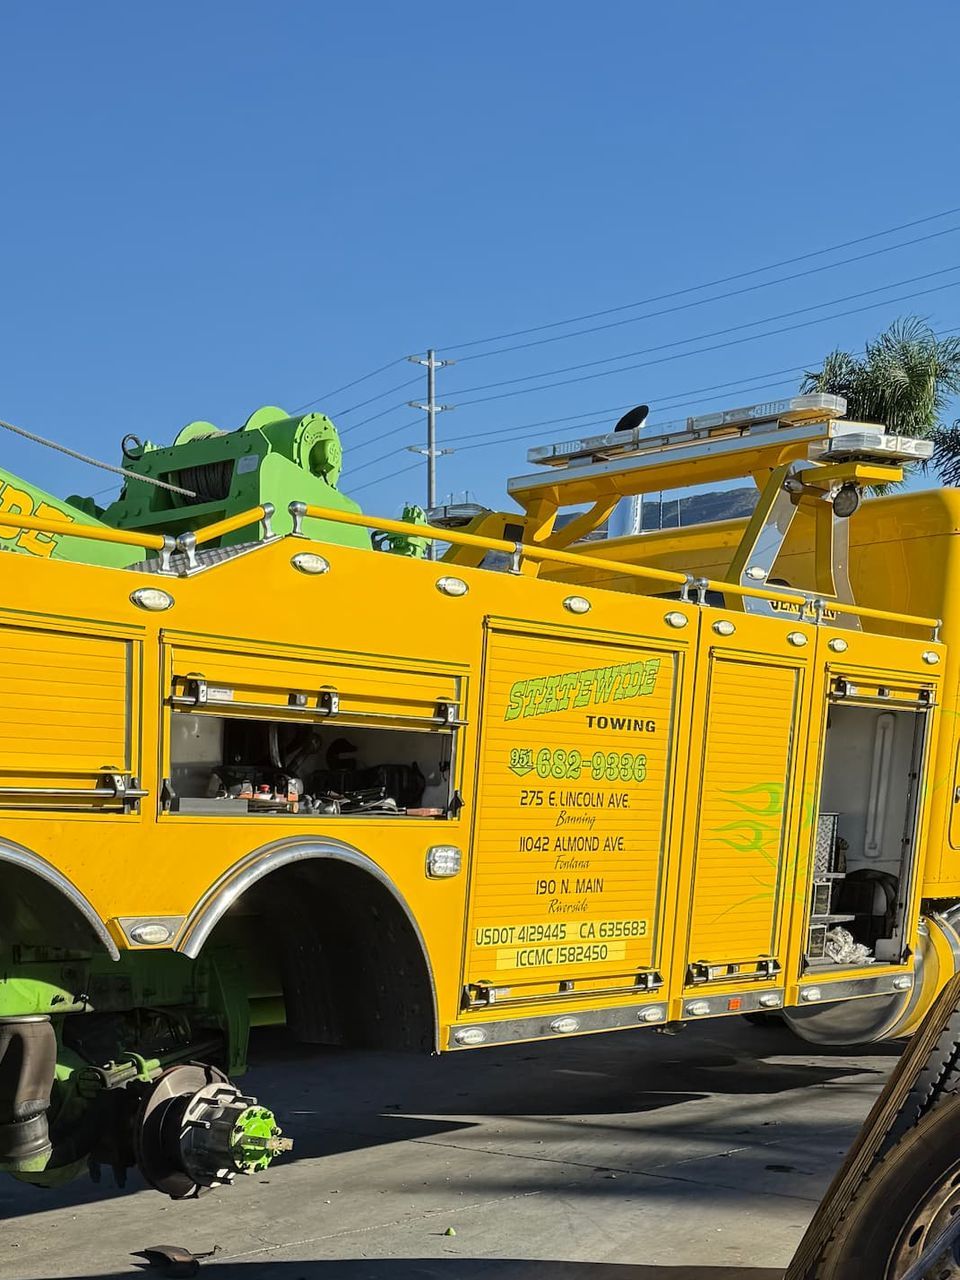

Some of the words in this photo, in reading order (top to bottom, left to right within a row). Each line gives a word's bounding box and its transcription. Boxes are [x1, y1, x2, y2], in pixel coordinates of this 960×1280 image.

[504, 658, 661, 722] STATEWIDE
[586, 715, 657, 732] TOWING
[510, 748, 534, 767] 951
[536, 748, 647, 782] 682-9336
[520, 790, 544, 806] 275
[560, 792, 604, 808] LINCOLN
[607, 793, 631, 808] AVE.
[555, 810, 597, 831] Banning
[519, 836, 550, 852] 11042
[553, 836, 600, 852] ALMOND
[603, 836, 626, 852] AVE.
[554, 855, 590, 870] Fontana
[536, 879, 556, 895] 190
[560, 878, 571, 894] N.
[575, 878, 604, 894] MAIN
[548, 898, 589, 914] Riverside
[476, 927, 516, 946] USDOT
[517, 924, 567, 942] 4129445
[579, 922, 596, 939] CA
[599, 920, 647, 938] 635683
[556, 944, 608, 964] 1582450
